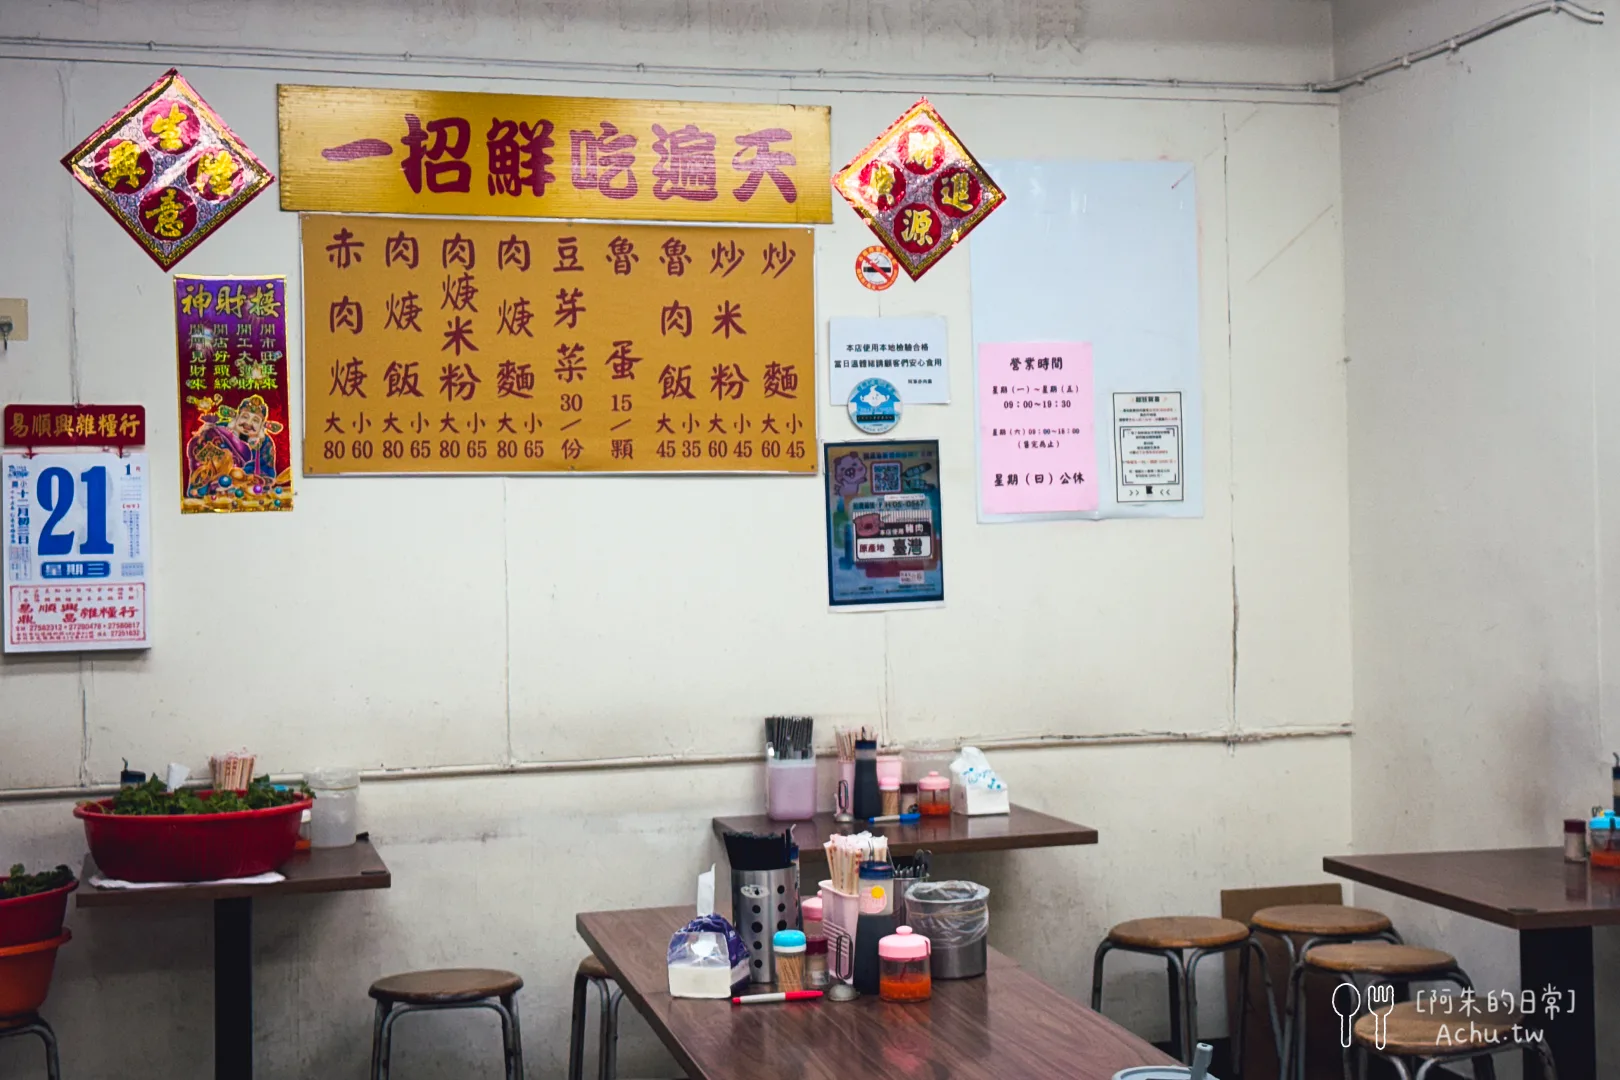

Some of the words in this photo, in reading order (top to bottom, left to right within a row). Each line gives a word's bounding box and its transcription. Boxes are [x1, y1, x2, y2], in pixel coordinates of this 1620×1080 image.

[321, 113, 798, 203] 一招鮮吃遍天
[553, 236, 587, 383] 豆芽菜
[658, 237, 696, 400] 魯肉飯
[710, 240, 749, 401] 炒米粉
[1010, 356, 1063, 371] 營業時間
[560, 394, 583, 412] 30
[611, 394, 632, 412] 15
[10, 412, 140, 438] 易順興雜糧行
[324, 440, 345, 459] 80
[351, 440, 374, 459] 60
[382, 440, 404, 459] 80
[410, 440, 432, 459] 65
[439, 440, 461, 459] 80
[467, 440, 488, 459] 65
[497, 440, 518, 459] 80
[524, 440, 545, 459] 65
[561, 438, 584, 460] 份
[656, 440, 676, 459] 45
[682, 440, 701, 459] 35
[708, 440, 728, 459] 60
[733, 440, 753, 459] 45
[761, 440, 781, 459] 60
[785, 440, 805, 459] 45
[125, 463, 131, 475] 1
[36, 465, 114, 556] 21
[45, 563, 105, 577] 星期三
